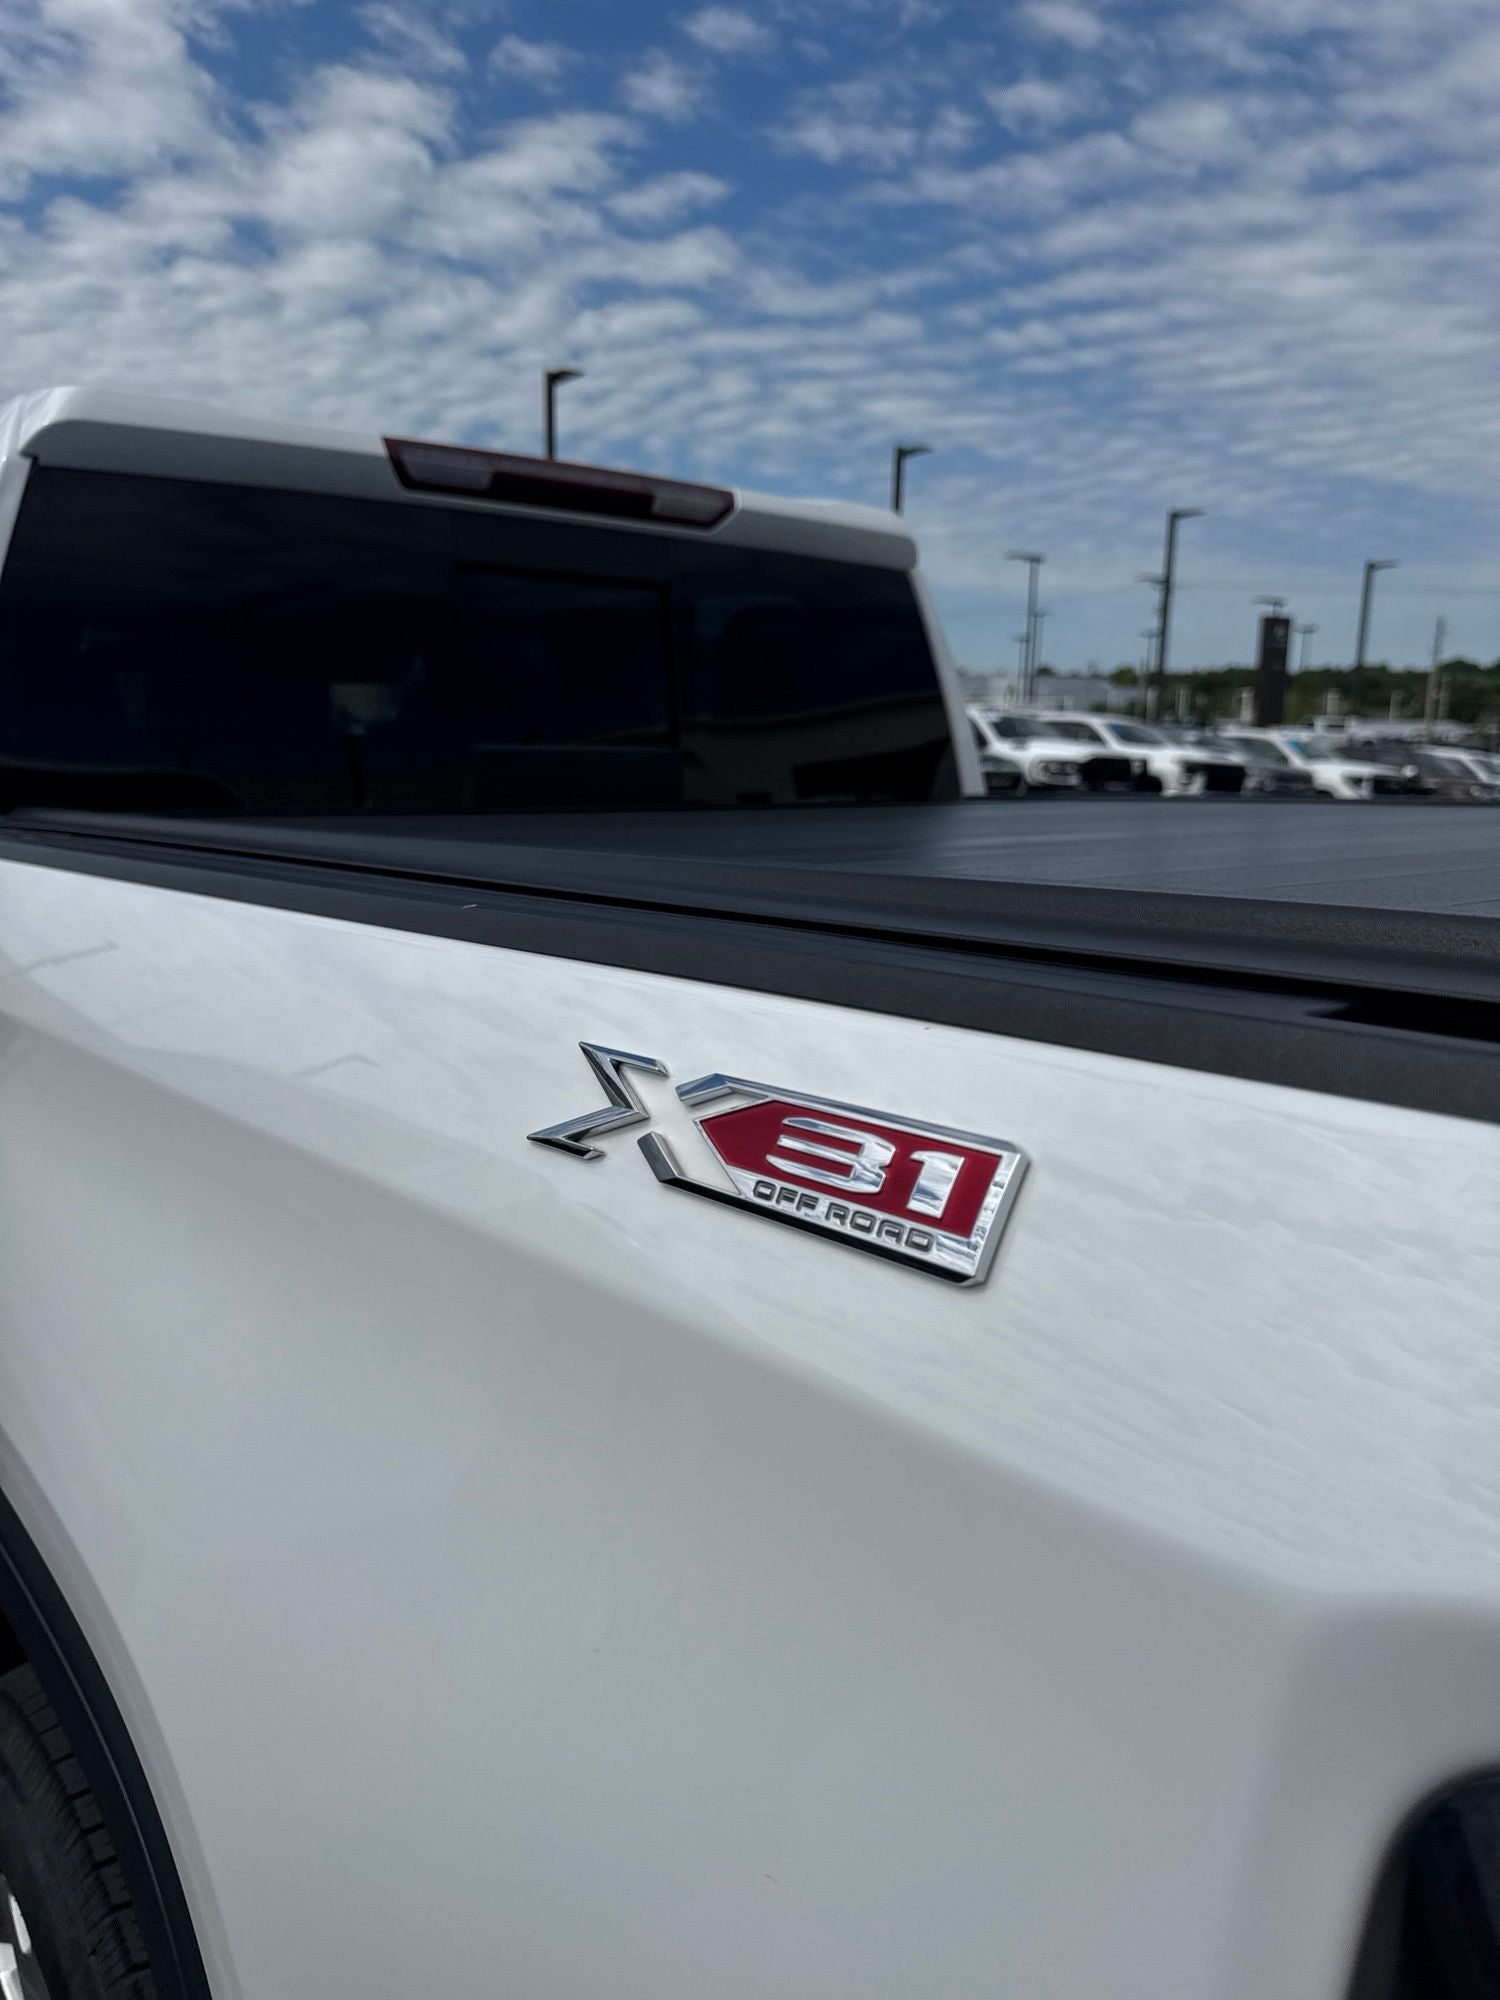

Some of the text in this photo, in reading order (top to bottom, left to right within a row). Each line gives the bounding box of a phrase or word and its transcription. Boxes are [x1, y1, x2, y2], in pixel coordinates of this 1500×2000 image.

[527, 1041, 965, 1220] X31
[753, 1179, 935, 1253] OFF ROAD
